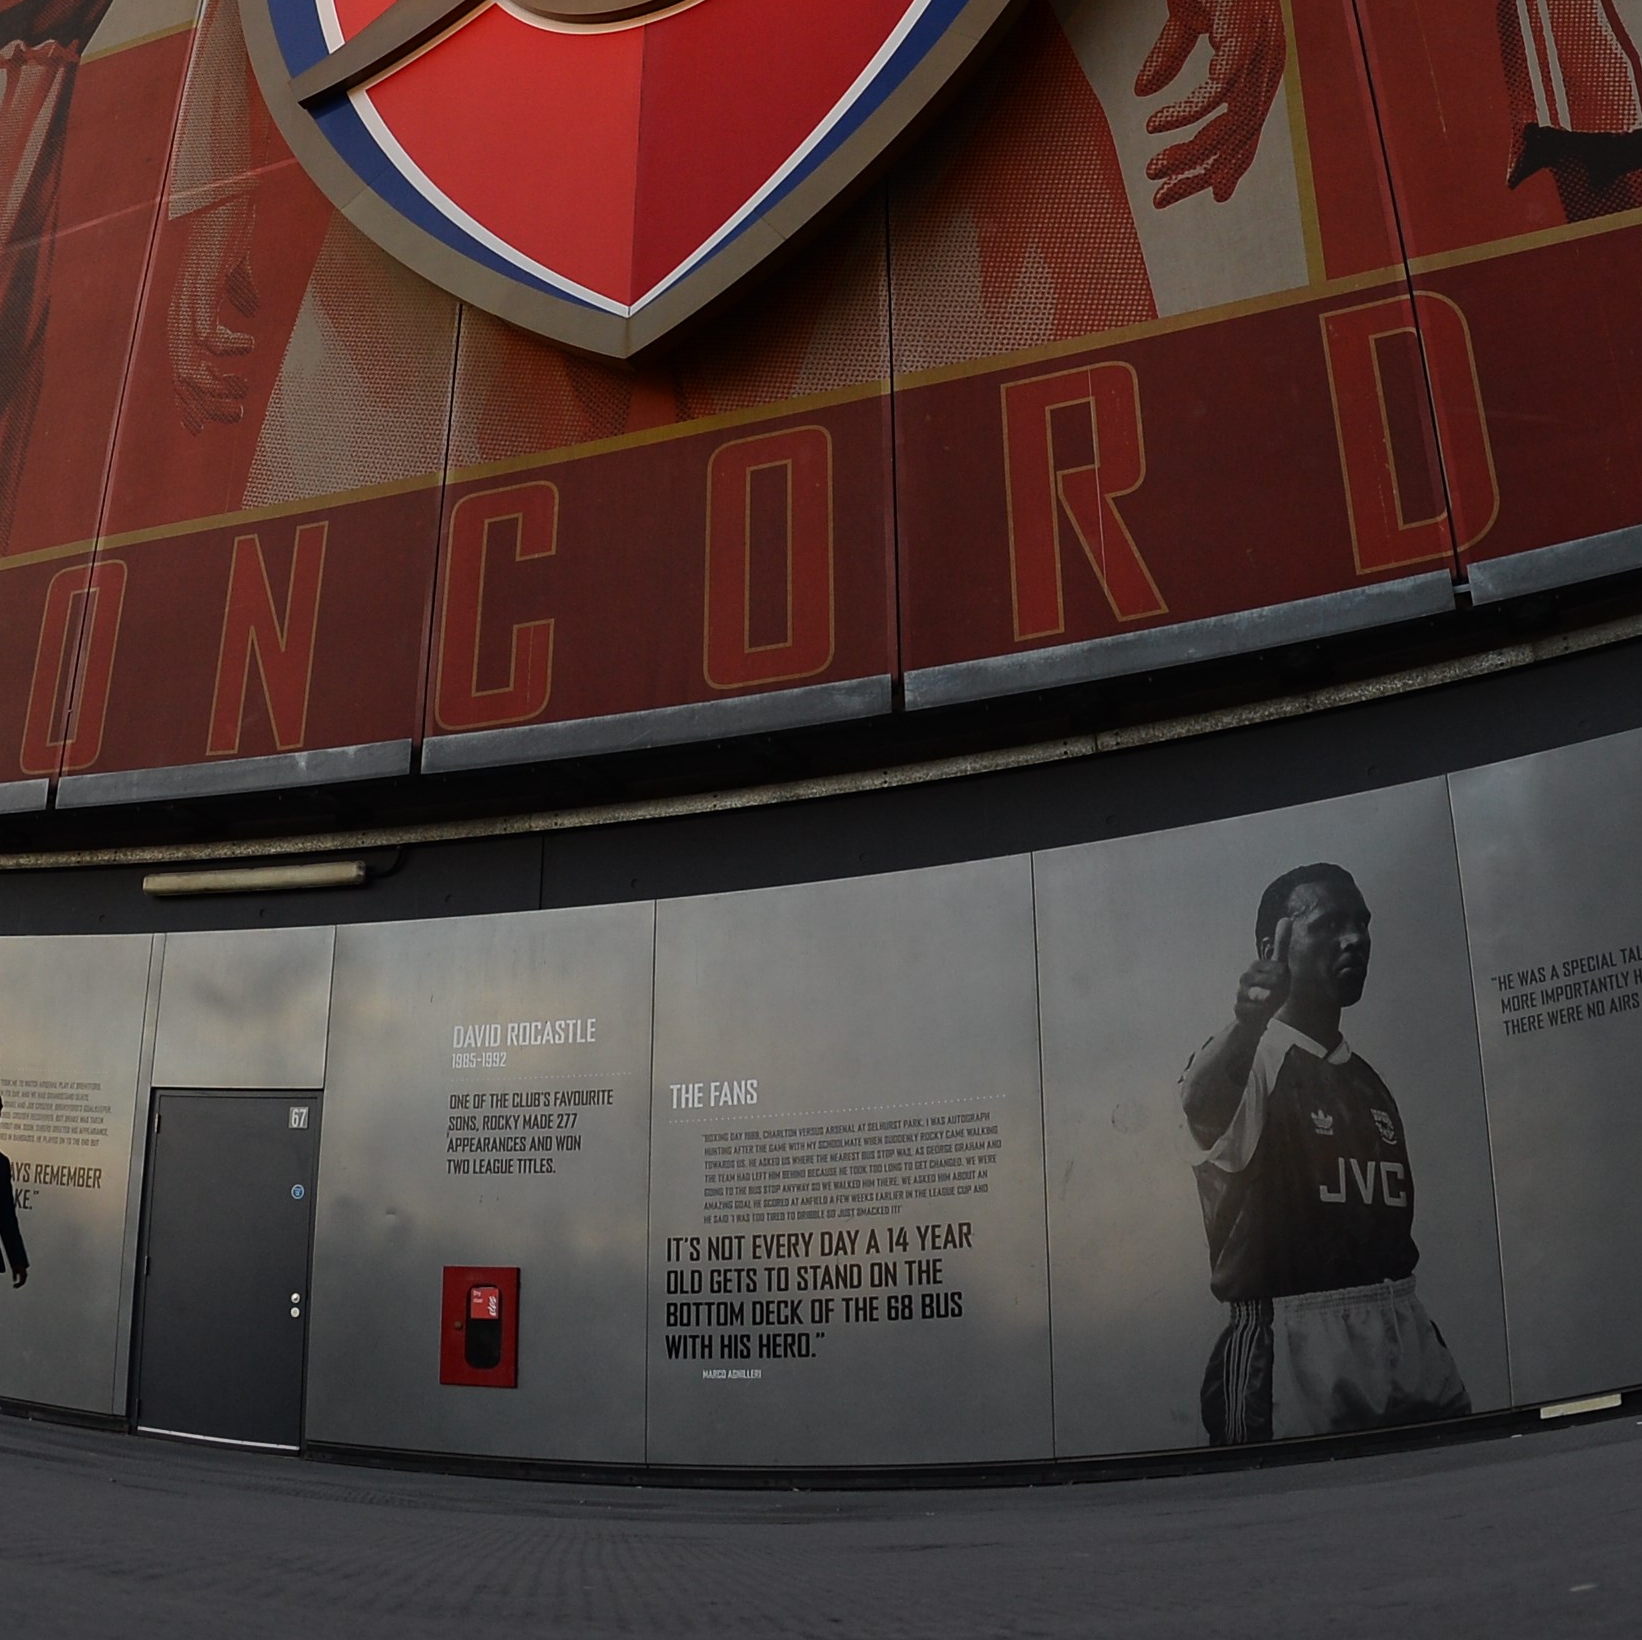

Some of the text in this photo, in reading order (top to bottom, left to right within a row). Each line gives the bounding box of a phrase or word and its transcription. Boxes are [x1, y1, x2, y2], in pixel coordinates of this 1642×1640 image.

[1518, 968, 1546, 988] WAS
[1550, 965, 1560, 980] A
[1562, 952, 1617, 978] SPECIAL
[1501, 992, 1537, 1014] MORE
[1540, 970, 1630, 1006] IMPORTANTLY
[1503, 1014, 1545, 1036] THERE
[1547, 1007, 1583, 1027] WERE
[1586, 1001, 1606, 1019] NO
[1609, 993, 1641, 1015] AIRS
[453, 1019, 597, 1048] DAVID ROCASTLE
[452, 1052, 507, 1068] 1985-1992
[450, 1089, 613, 1109] ONE OF THE CLUB'S FAVOURITE
[670, 1080, 757, 1109] THE FANS
[291, 1108, 308, 1127] 67
[448, 1113, 577, 1132] SONS, ROCKY MADE 277
[447, 1135, 581, 1152] APPEARANCES AND WON
[35, 1164, 102, 1189] REMEMBER
[447, 1158, 556, 1174] TWO LEAGUE TITLES.
[1319, 1157, 1406, 1207] JVC
[666, 1222, 973, 1262] IT'S NOT EVERY DAY A 14 YEAR
[666, 1259, 943, 1295] OLD GETS TO STAND ON THE
[666, 1291, 964, 1327] BOTTOM DECK OF THE 68 BUS
[666, 1334, 713, 1360] WITH
[720, 1334, 751, 1359] HIS
